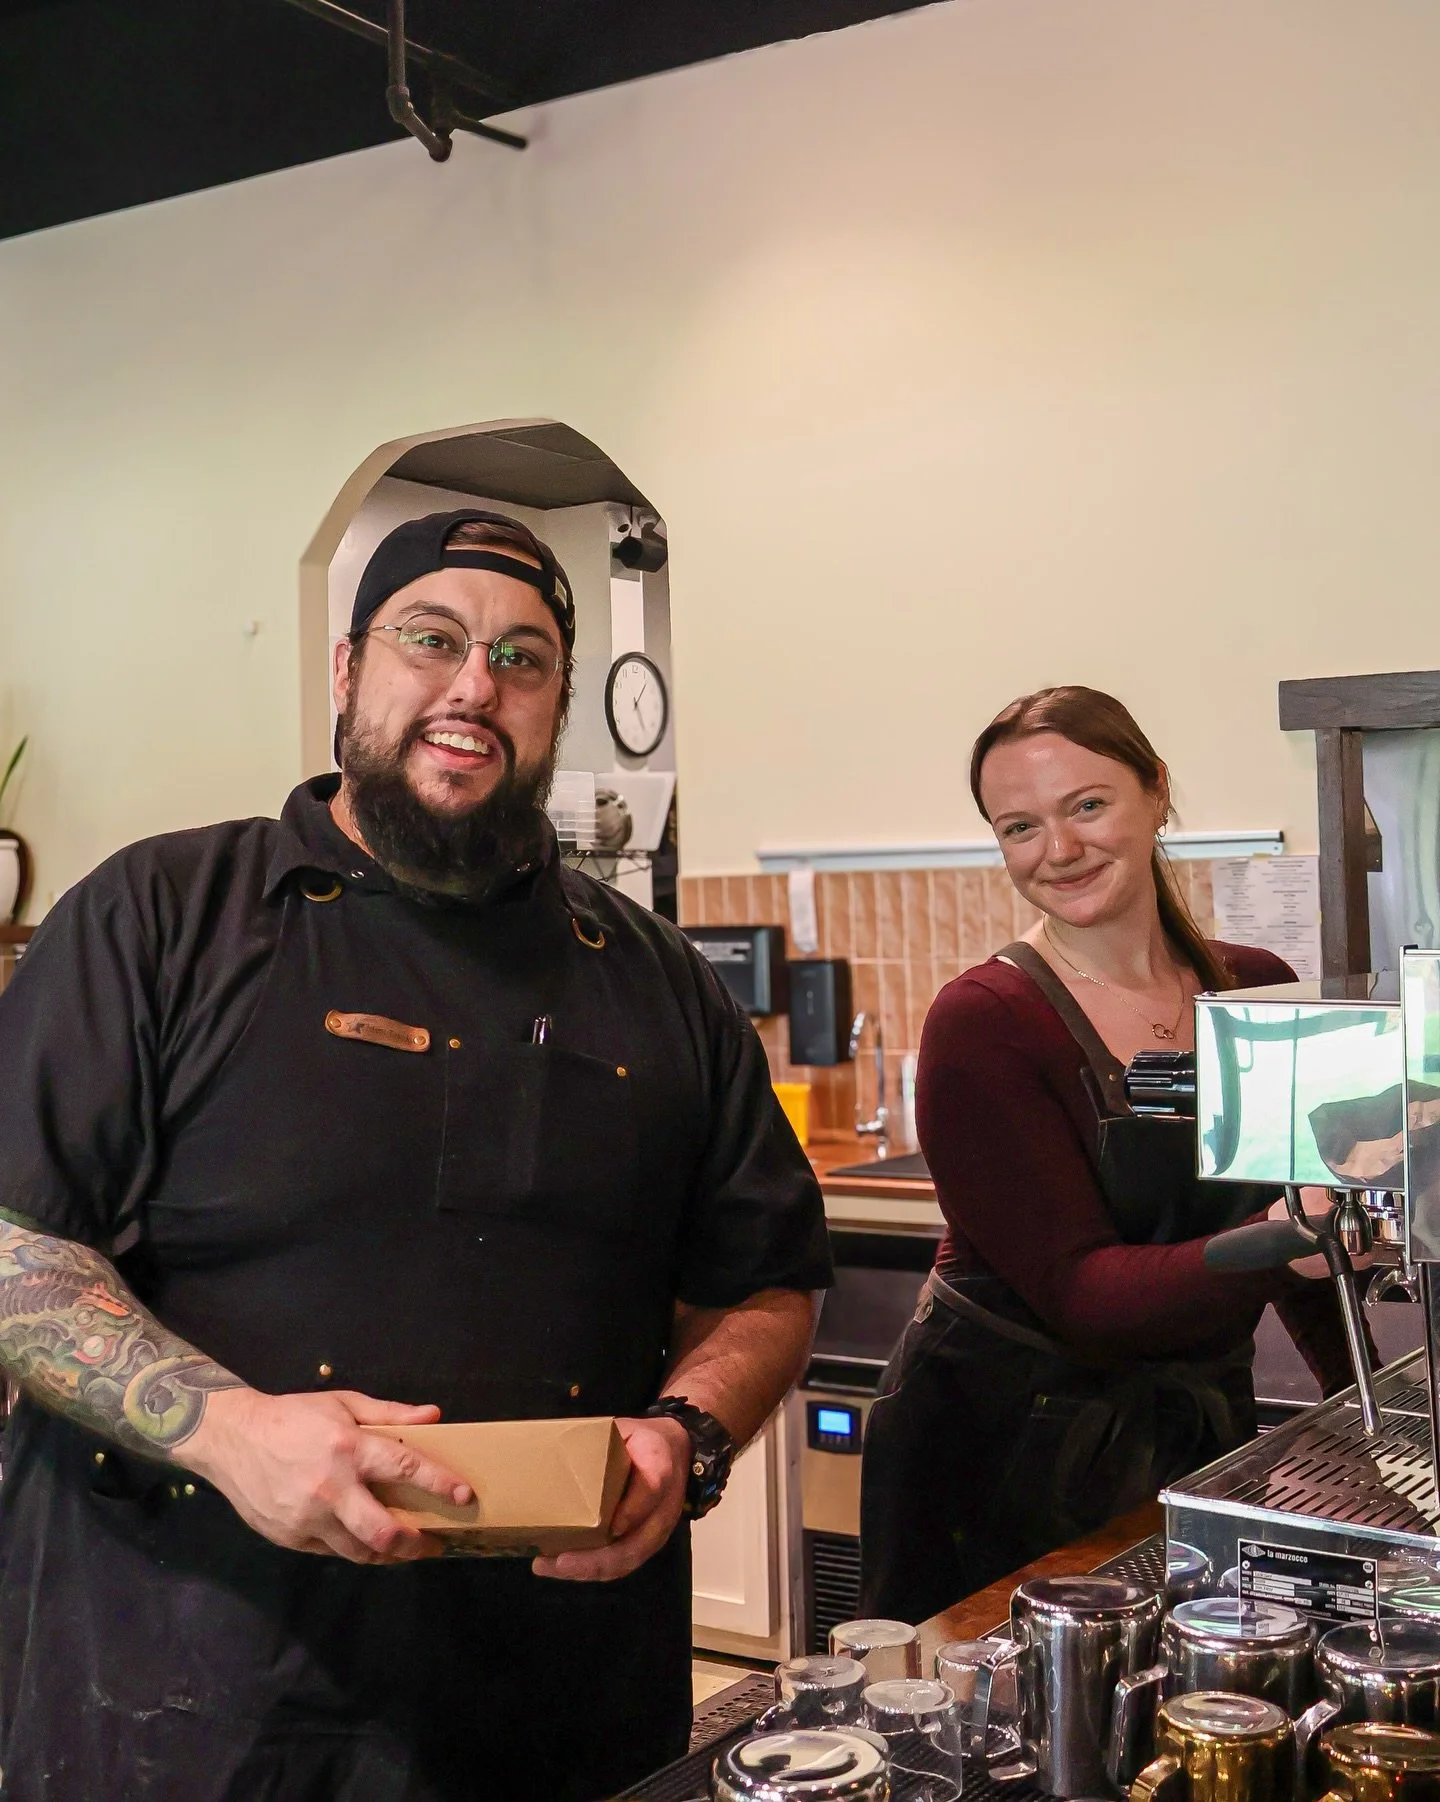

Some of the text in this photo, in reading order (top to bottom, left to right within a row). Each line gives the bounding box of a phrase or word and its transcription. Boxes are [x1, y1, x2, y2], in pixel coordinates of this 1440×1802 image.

[622, 668, 628, 678] 11
[632, 665, 639, 674] 12
[1267, 1549, 1309, 1563] la marzocco
